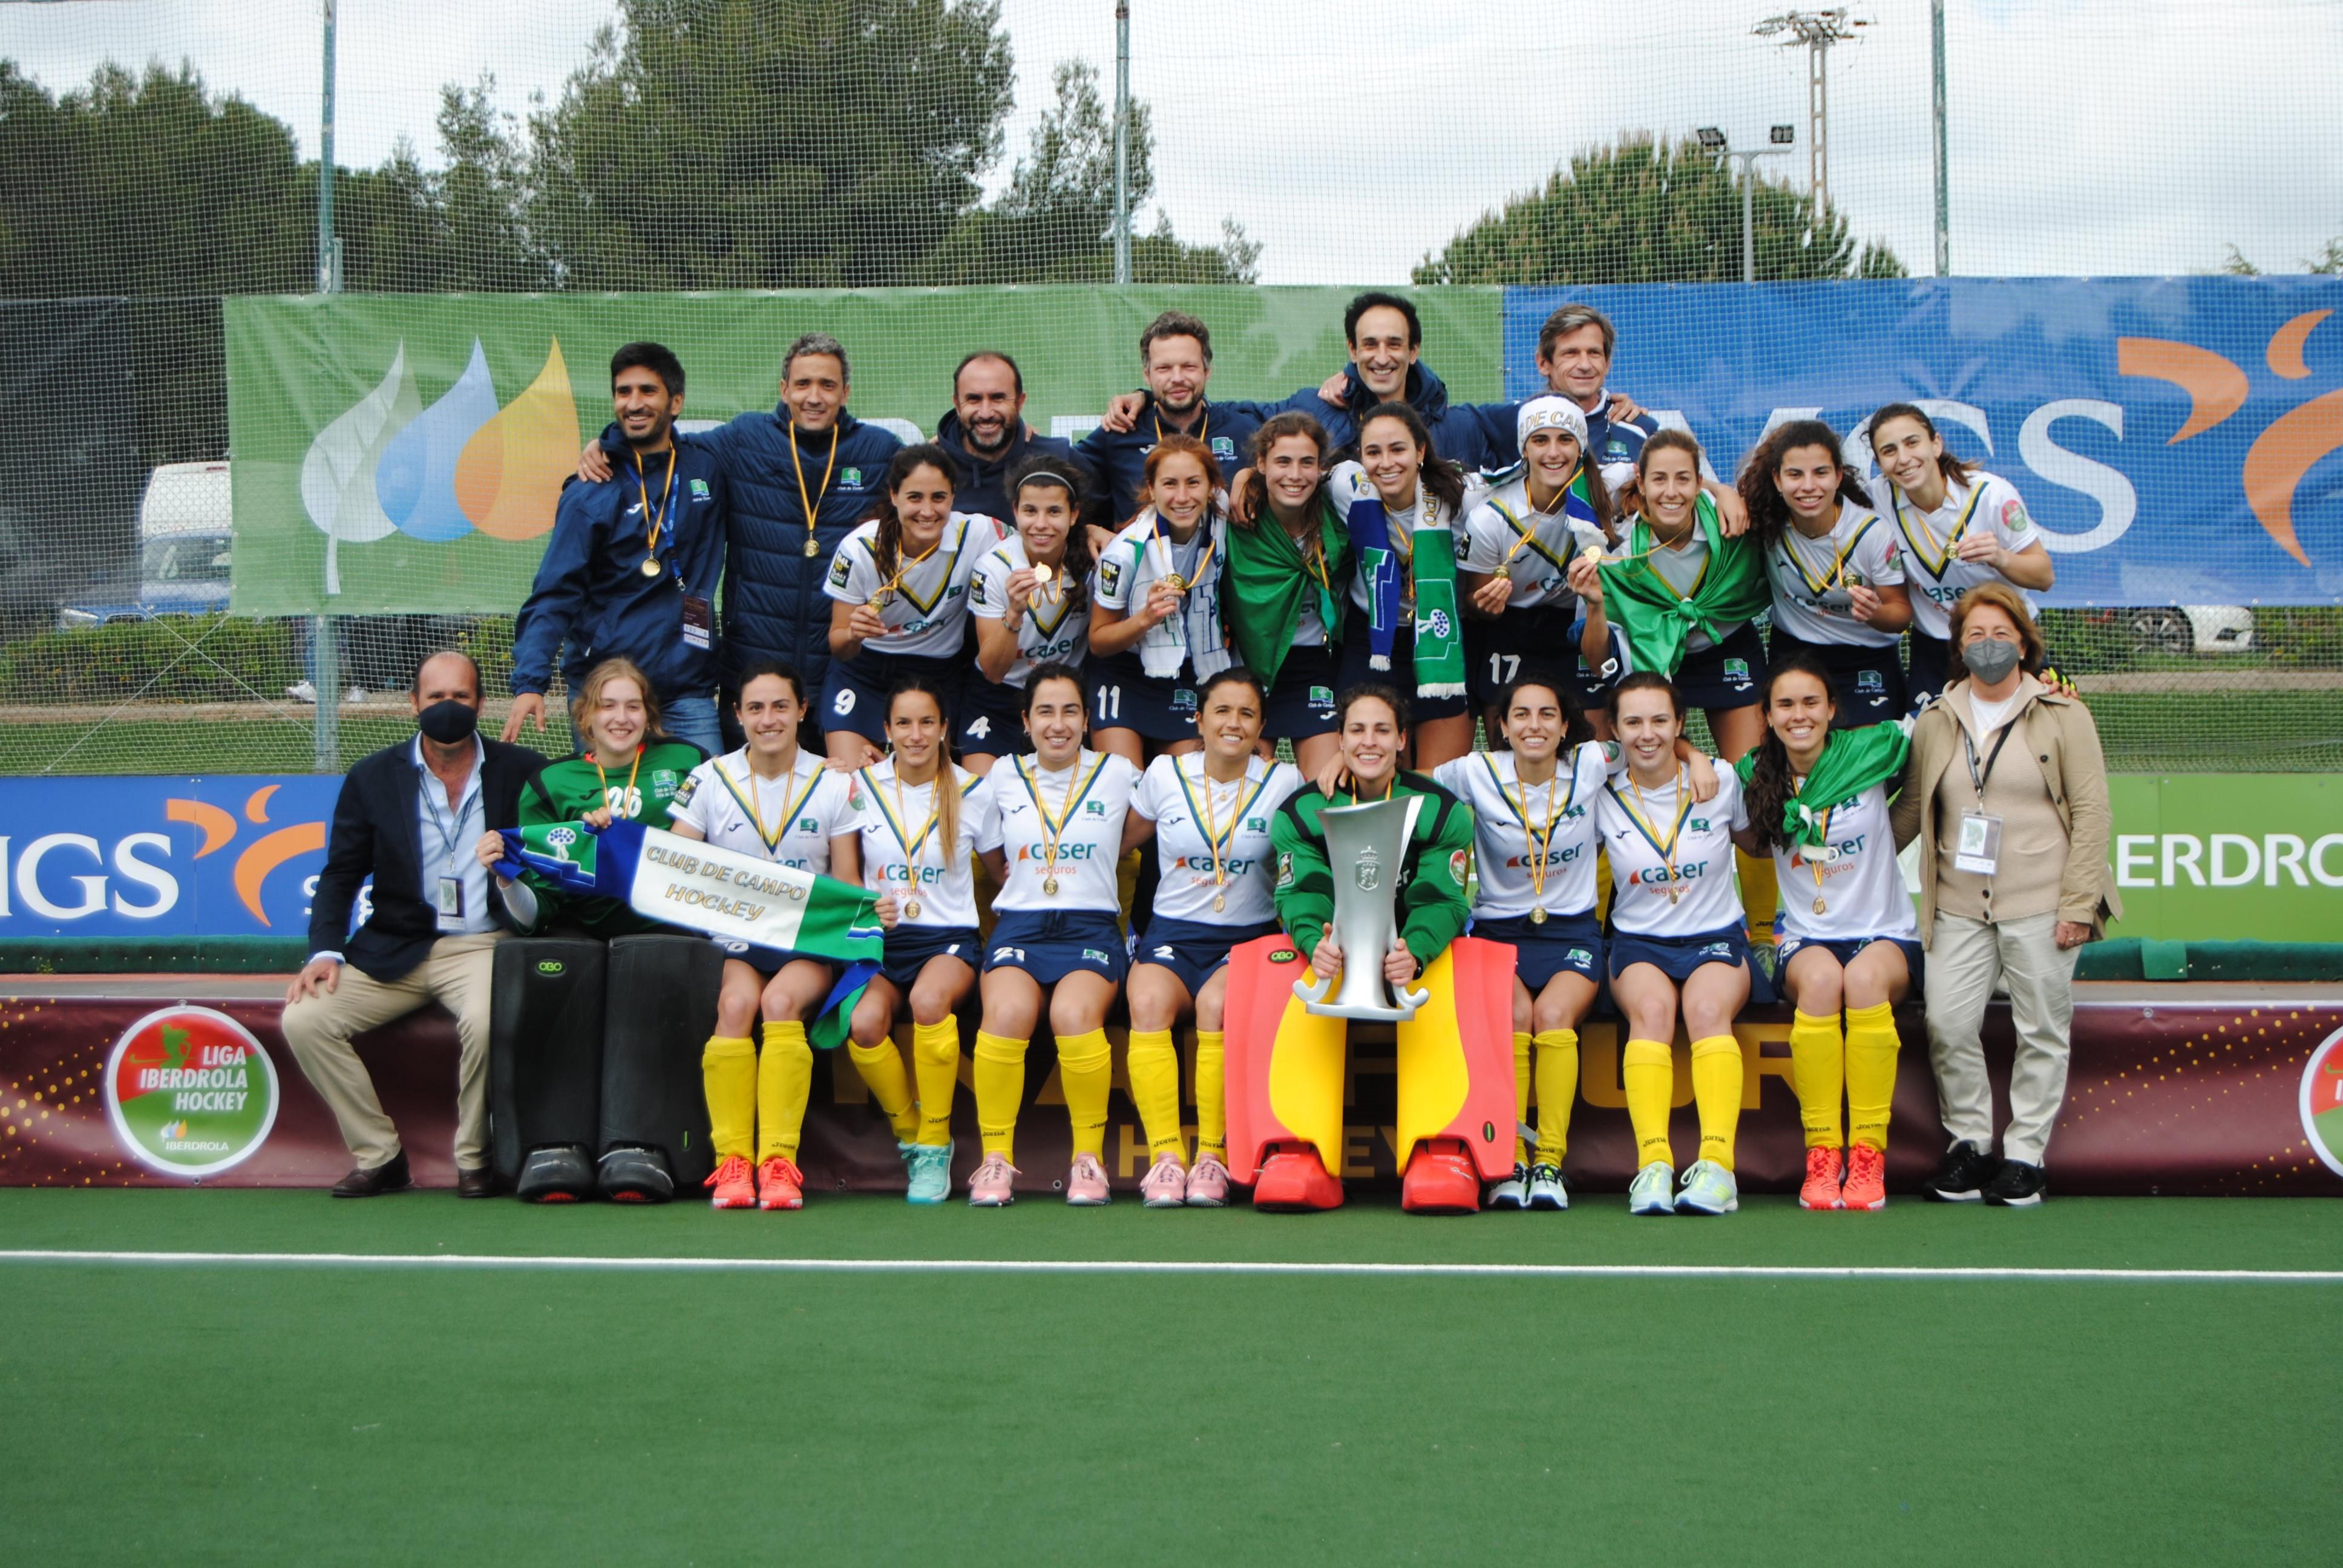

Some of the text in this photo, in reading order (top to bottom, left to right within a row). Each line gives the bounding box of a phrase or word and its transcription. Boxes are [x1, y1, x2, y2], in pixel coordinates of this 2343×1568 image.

[1525, 411, 1547, 433] DE
[1489, 652, 1521, 684] 17
[833, 688, 856, 716] 9
[1097, 685, 1121, 720] 11
[966, 715, 991, 739] 4
[608, 785, 642, 818] 26
[1820, 861, 1855, 878] eguros
[2108, 832, 2343, 887] ERDRO
[0, 832, 179, 919] GS
[647, 846, 807, 901] CLUB DE CAMPO
[1191, 876, 1232, 887] seguos
[1526, 866, 1568, 880] seuros
[1649, 884, 1690, 897] seguos
[992, 946, 1025, 962] 21
[1152, 945, 1175, 960] 2
[1271, 952, 1294, 961] OBO
[539, 962, 562, 971] OBO
[203, 1045, 247, 1065] LIGA
[140, 1068, 248, 1089] IBERDROLA
[175, 1091, 249, 1111] HOCKEY
[166, 1142, 229, 1151] IBERDROLA
